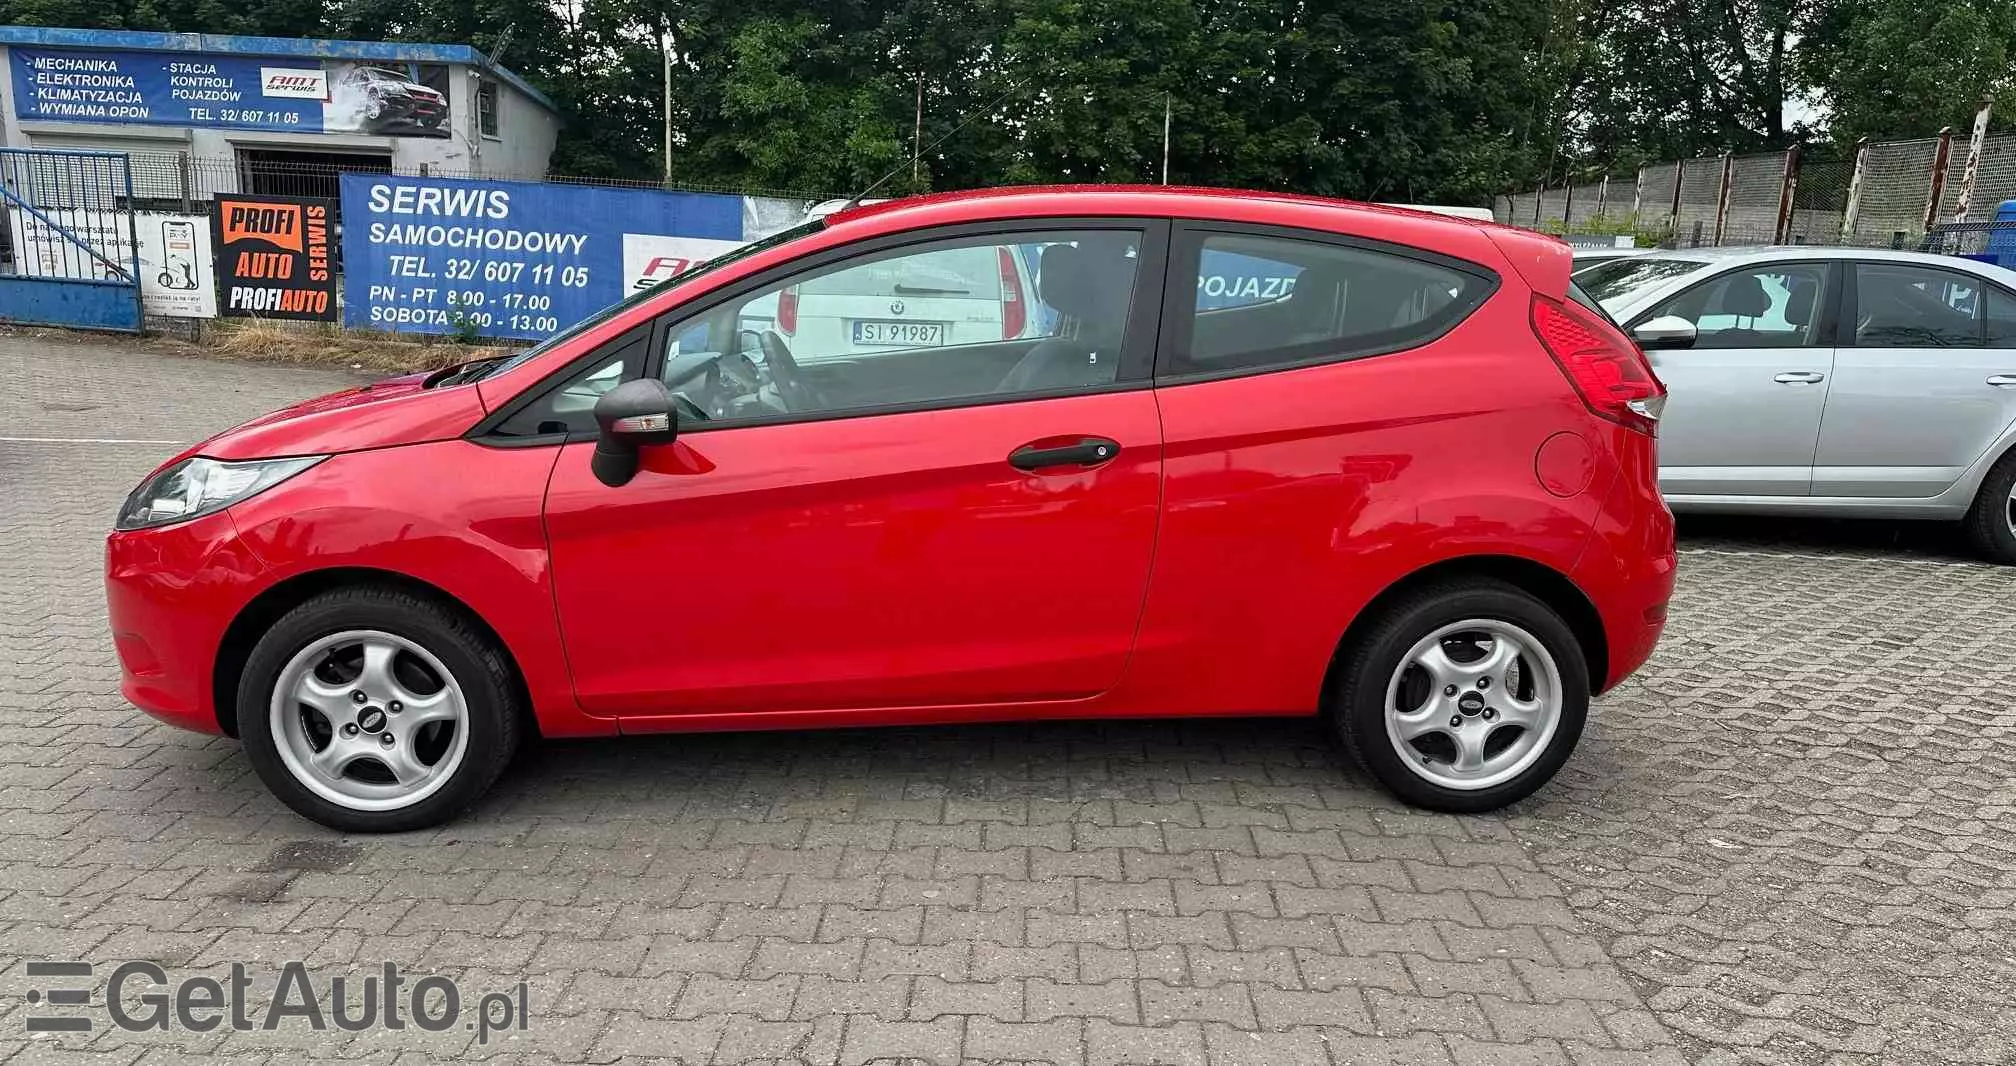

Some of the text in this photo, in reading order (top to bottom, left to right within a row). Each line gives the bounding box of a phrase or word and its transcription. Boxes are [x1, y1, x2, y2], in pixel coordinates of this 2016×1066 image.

[35, 57, 118, 73] MECHANIKA
[170, 63, 217, 75] STACJA
[37, 73, 135, 88] ELEKTRONIKA
[171, 76, 233, 89] KONTROLI
[38, 88, 143, 104] KLIMATYZACJA
[172, 88, 242, 102] POJAZDÓW
[40, 103, 105, 117] WYMIANA
[109, 106, 149, 119] OPON
[189, 108, 299, 124] TEL. 32/ 607 11 05
[368, 184, 511, 219] SERWIS
[229, 206, 295, 235] PROFI
[307, 206, 328, 281] SERWIS
[369, 222, 588, 256] SAMOCHODOWY
[235, 252, 293, 280] AUTO
[390, 255, 589, 287] TEL. 32/ 607 11 05
[229, 286, 329, 314] PROFIAUTO
[369, 286, 395, 302] PN
[412, 288, 437, 304] PT
[502, 293, 551, 311] 17.00
[370, 306, 449, 325] SOBOTA
[510, 314, 558, 332] 13.00
[865, 324, 938, 341] SI 91987
